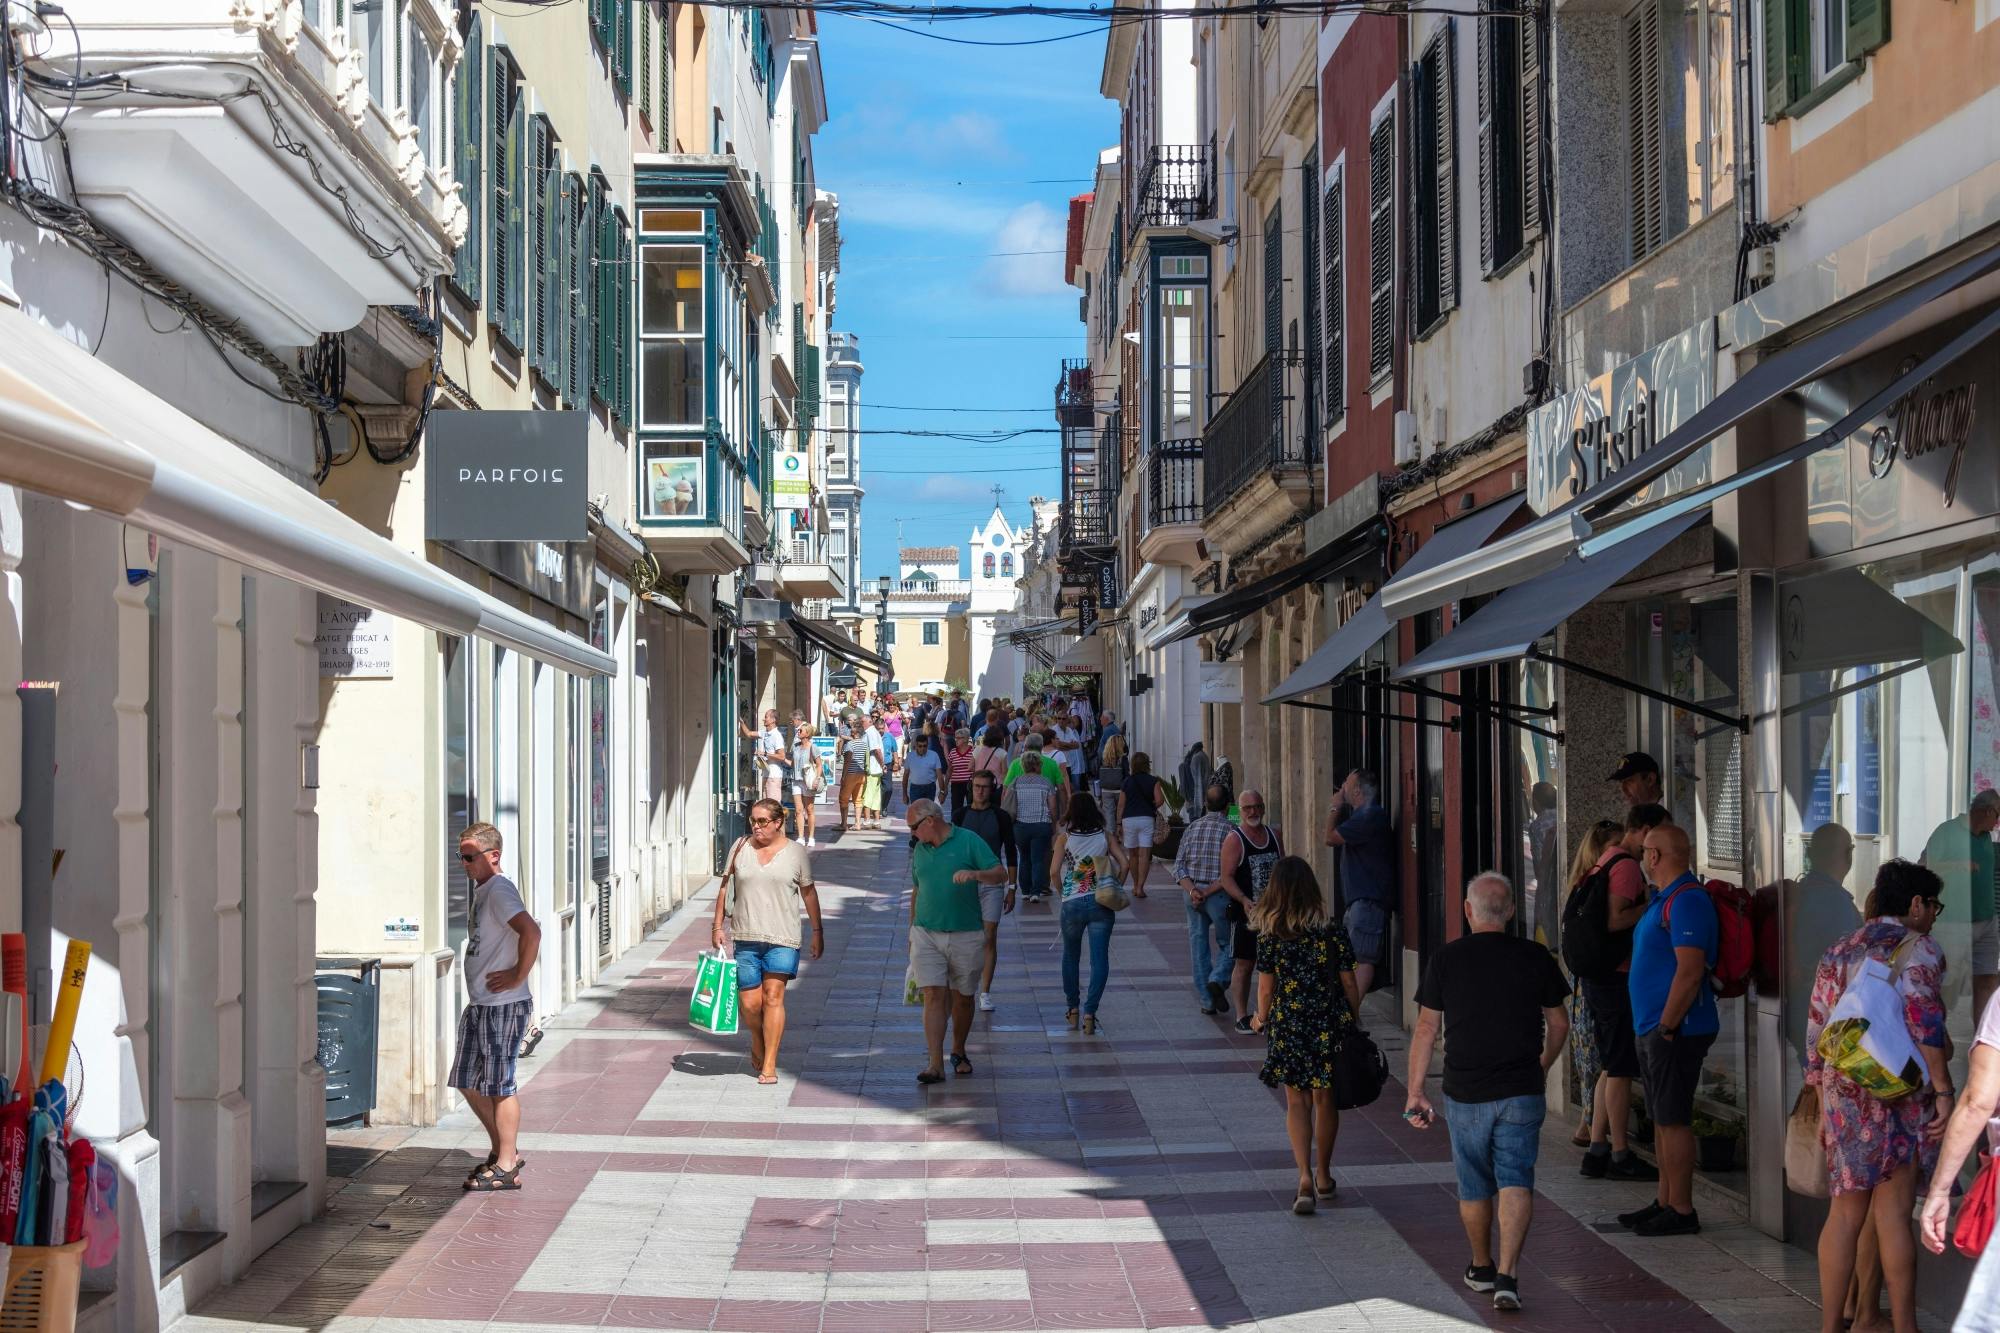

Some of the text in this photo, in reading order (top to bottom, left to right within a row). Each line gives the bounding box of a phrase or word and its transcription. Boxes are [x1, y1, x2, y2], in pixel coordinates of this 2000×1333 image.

[1569, 390, 1656, 498] S'Estil
[459, 468, 563, 483] PARFOIS
[1102, 567, 1111, 604] MANGO
[724, 981, 737, 1025] natura
